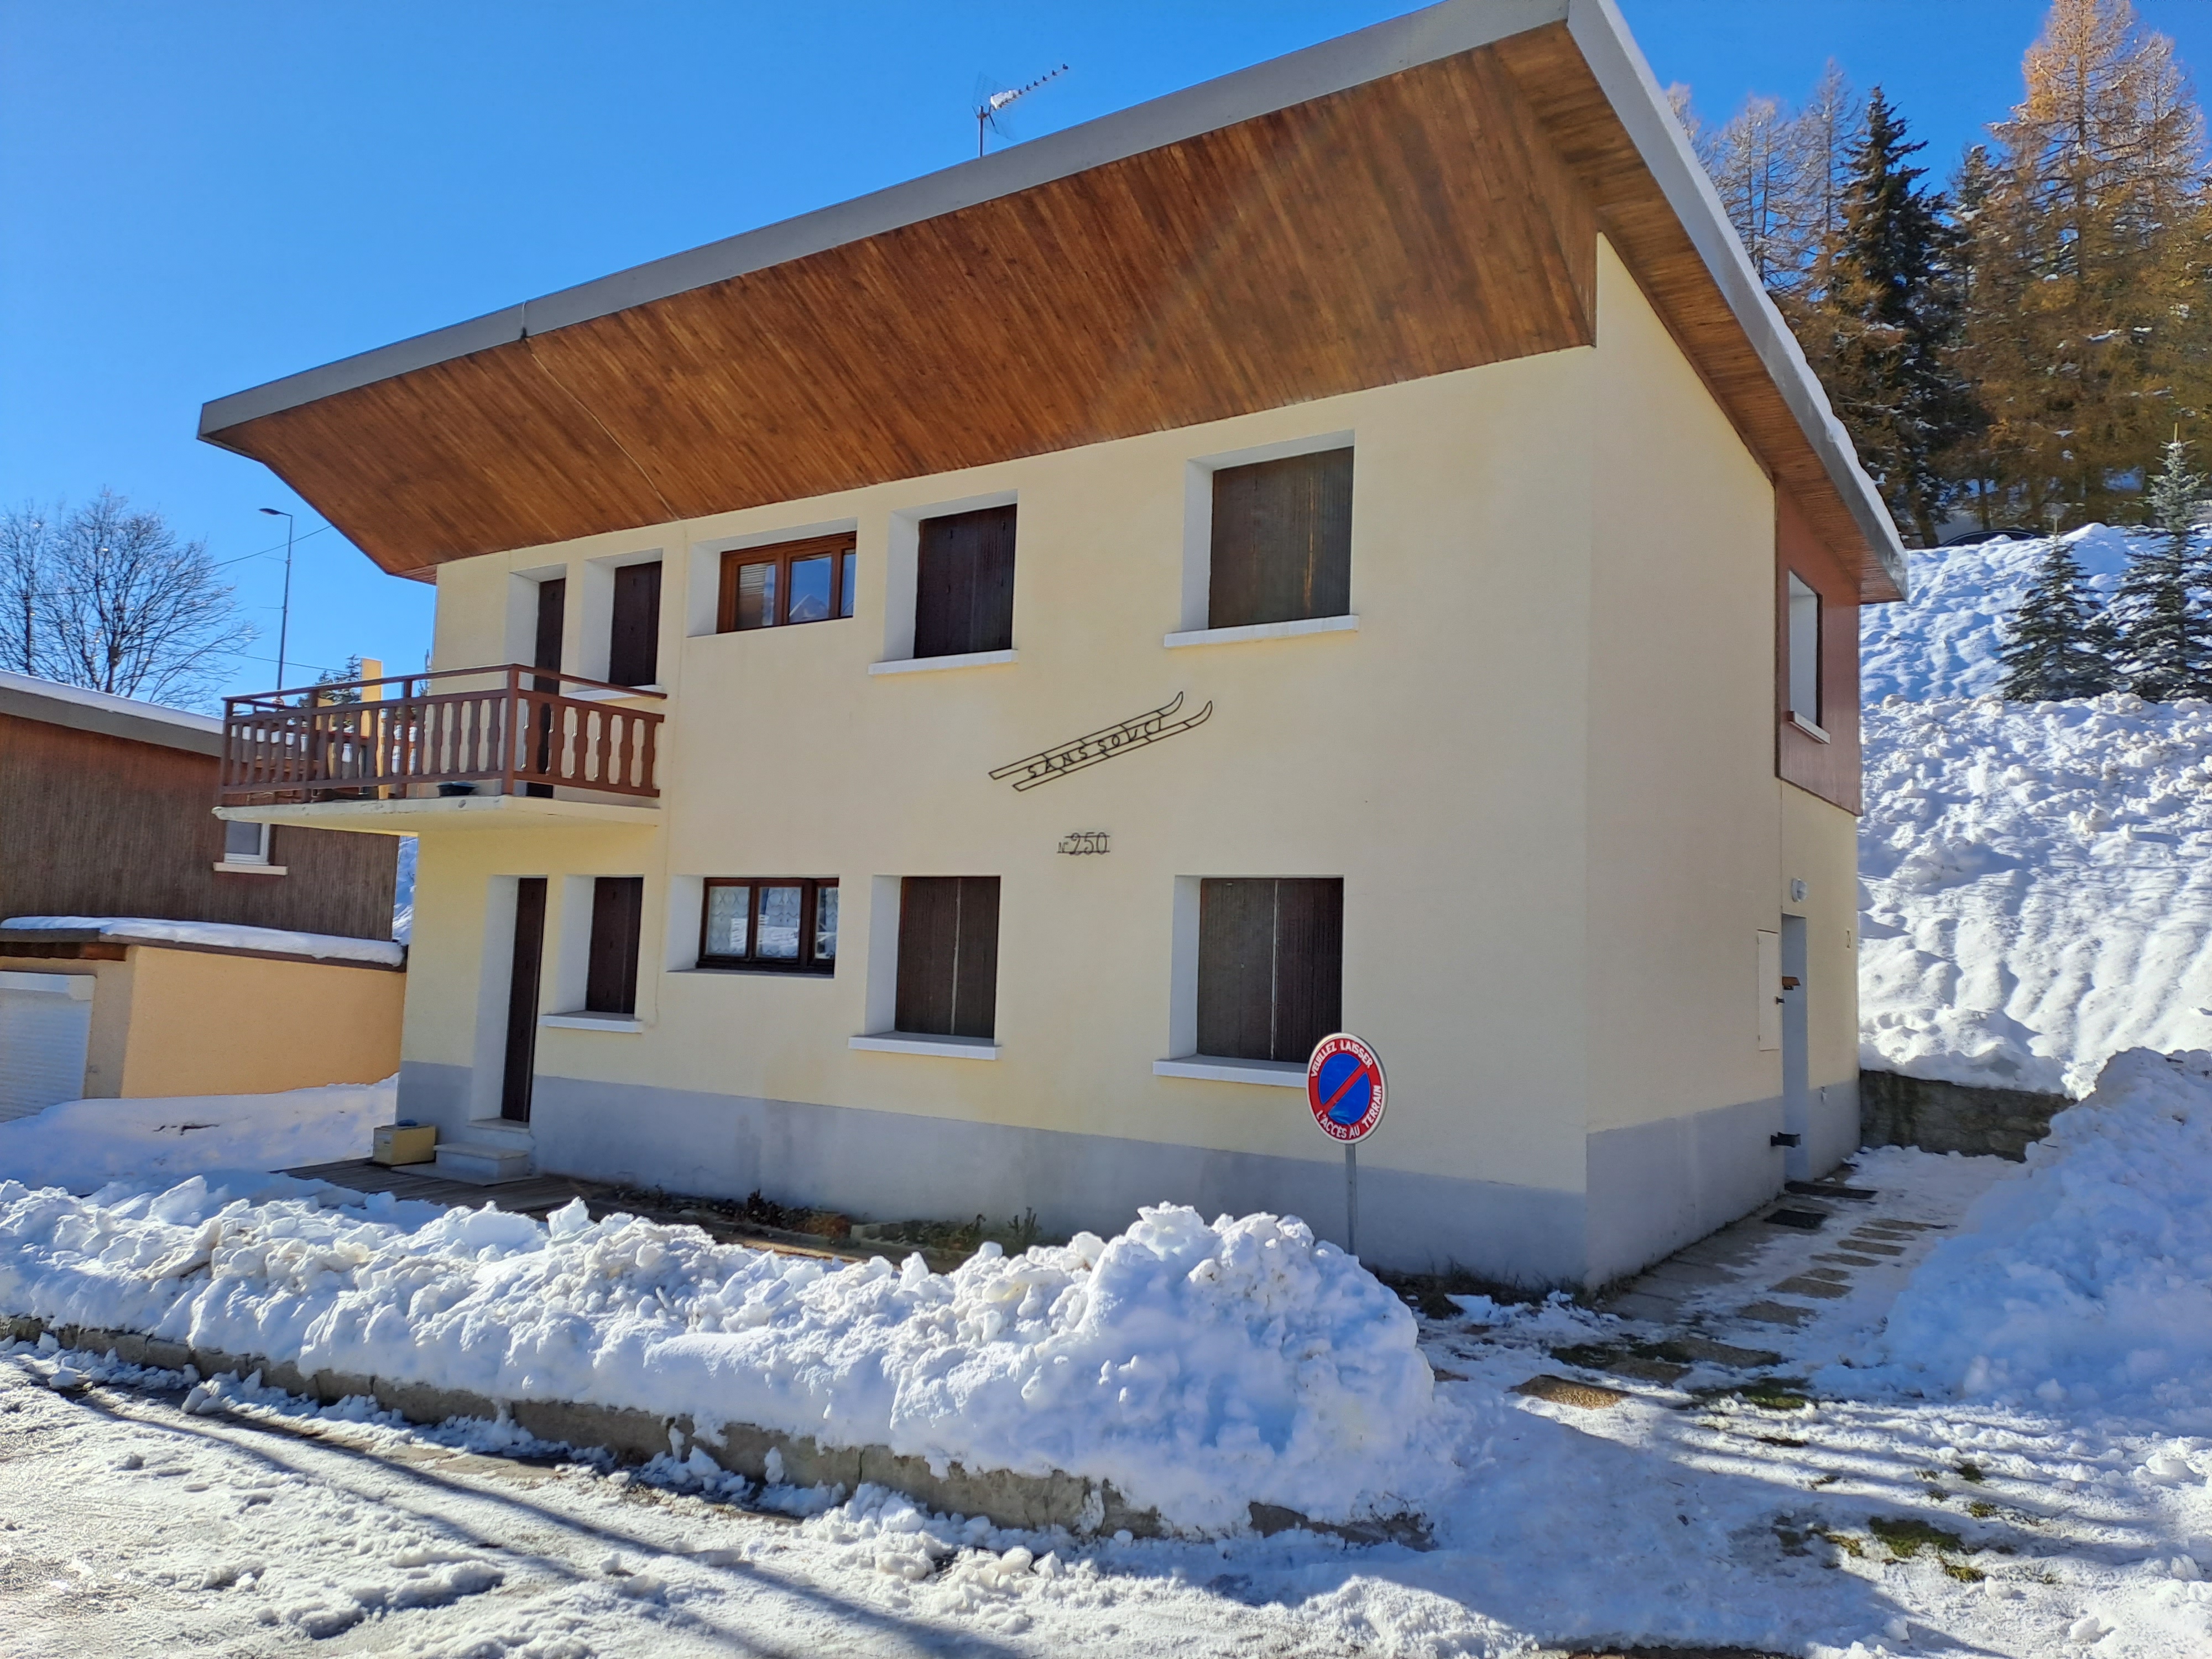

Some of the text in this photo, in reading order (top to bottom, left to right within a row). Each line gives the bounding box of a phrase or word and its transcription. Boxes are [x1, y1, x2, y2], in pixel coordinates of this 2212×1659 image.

[1027, 745, 1088, 779] SANS
[1311, 1040, 1373, 1077] VEUILLEZ LAISSER
[1349, 1126, 1360, 1139] AU
[1361, 1085, 1381, 1129] TERRAIN
